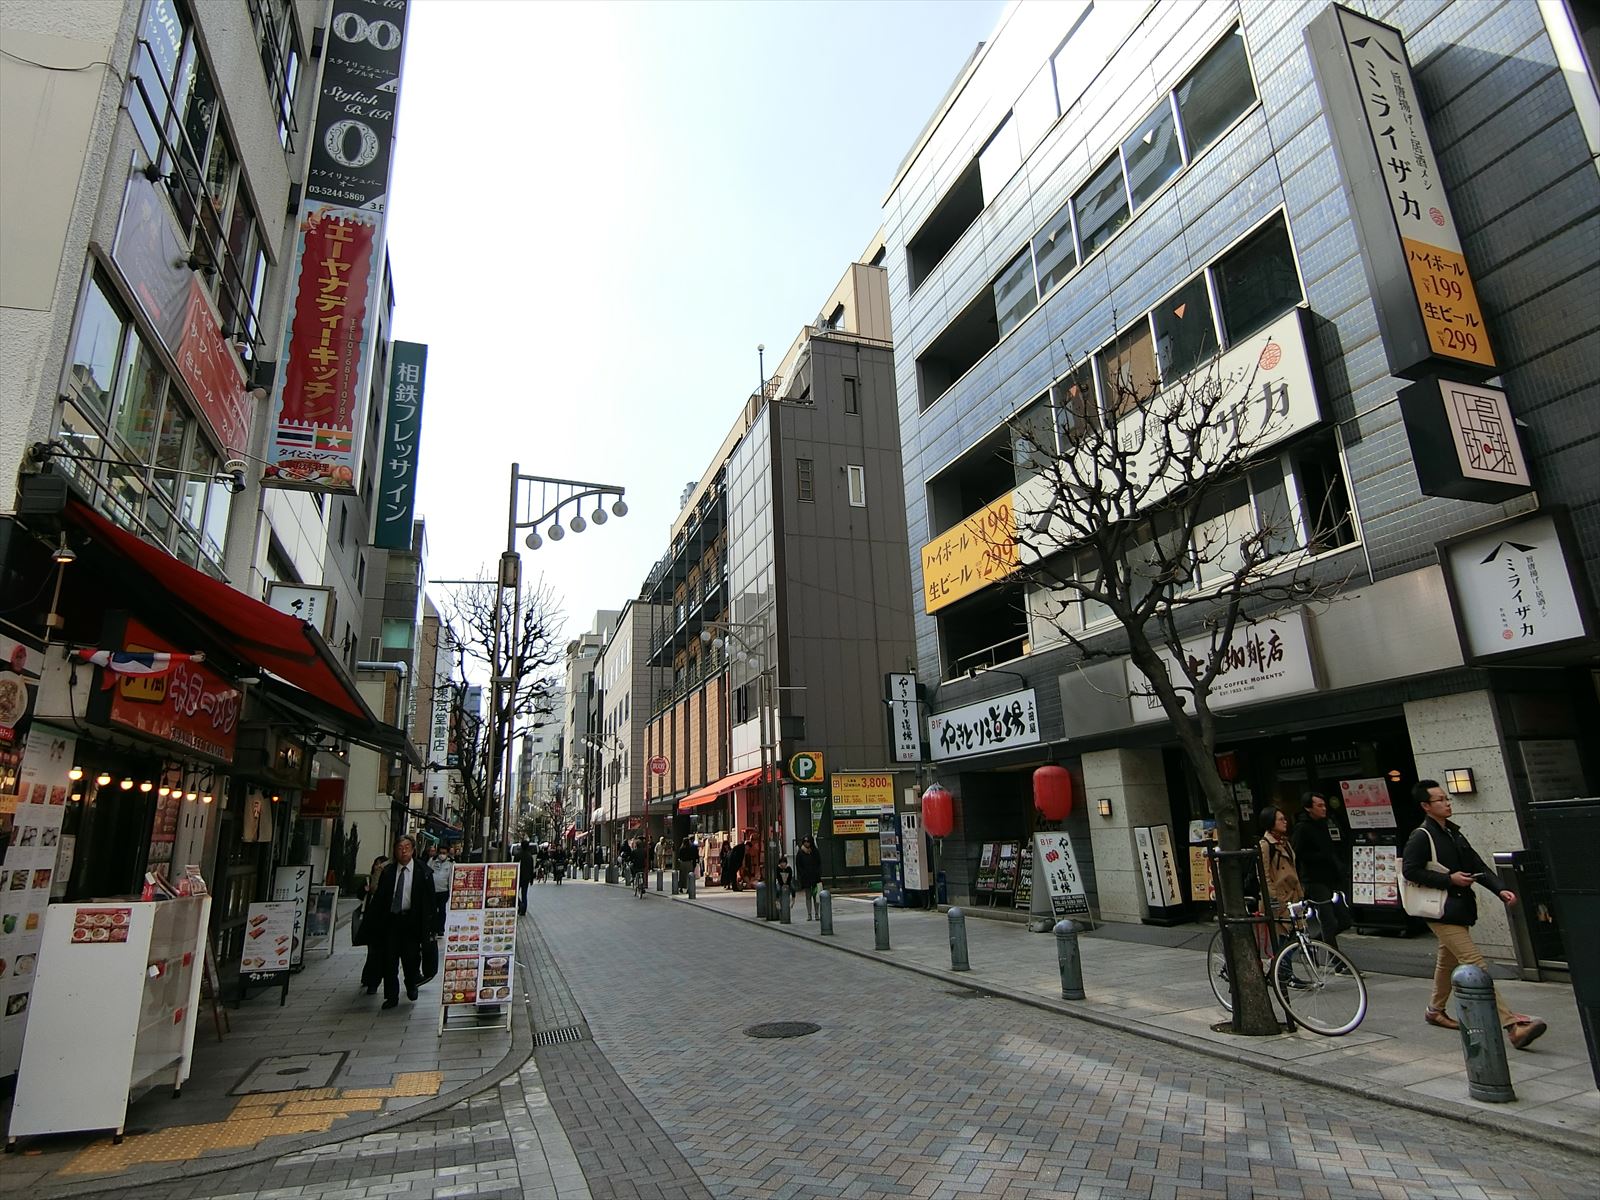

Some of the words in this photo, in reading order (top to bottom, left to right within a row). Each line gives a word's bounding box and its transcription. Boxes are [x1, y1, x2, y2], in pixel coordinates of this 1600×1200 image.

[324, 85, 378, 106] Stylish
[344, 103, 392, 121] BAR
[1365, 59, 1421, 221] ミライザカ
[308, 185, 365, 202] 03-5244-5869
[1410, 250, 1465, 277] ハイボール
[1424, 302, 1480, 328] 生ビール
[278, 448, 350, 461] タイとミャンマー
[385, 362, 420, 523] 相鉄フレッサイン
[926, 533, 970, 569] ハイボール
[928, 564, 973, 603] 生ビール
[1506, 558, 1535, 638] ミライザカ
[432, 687, 449, 752] 東京堂書店
[898, 676, 913, 741] やきとり道場
[931, 718, 943, 730] B1F
[940, 700, 1026, 755] やきとり道場
[799, 757, 813, 777] P
